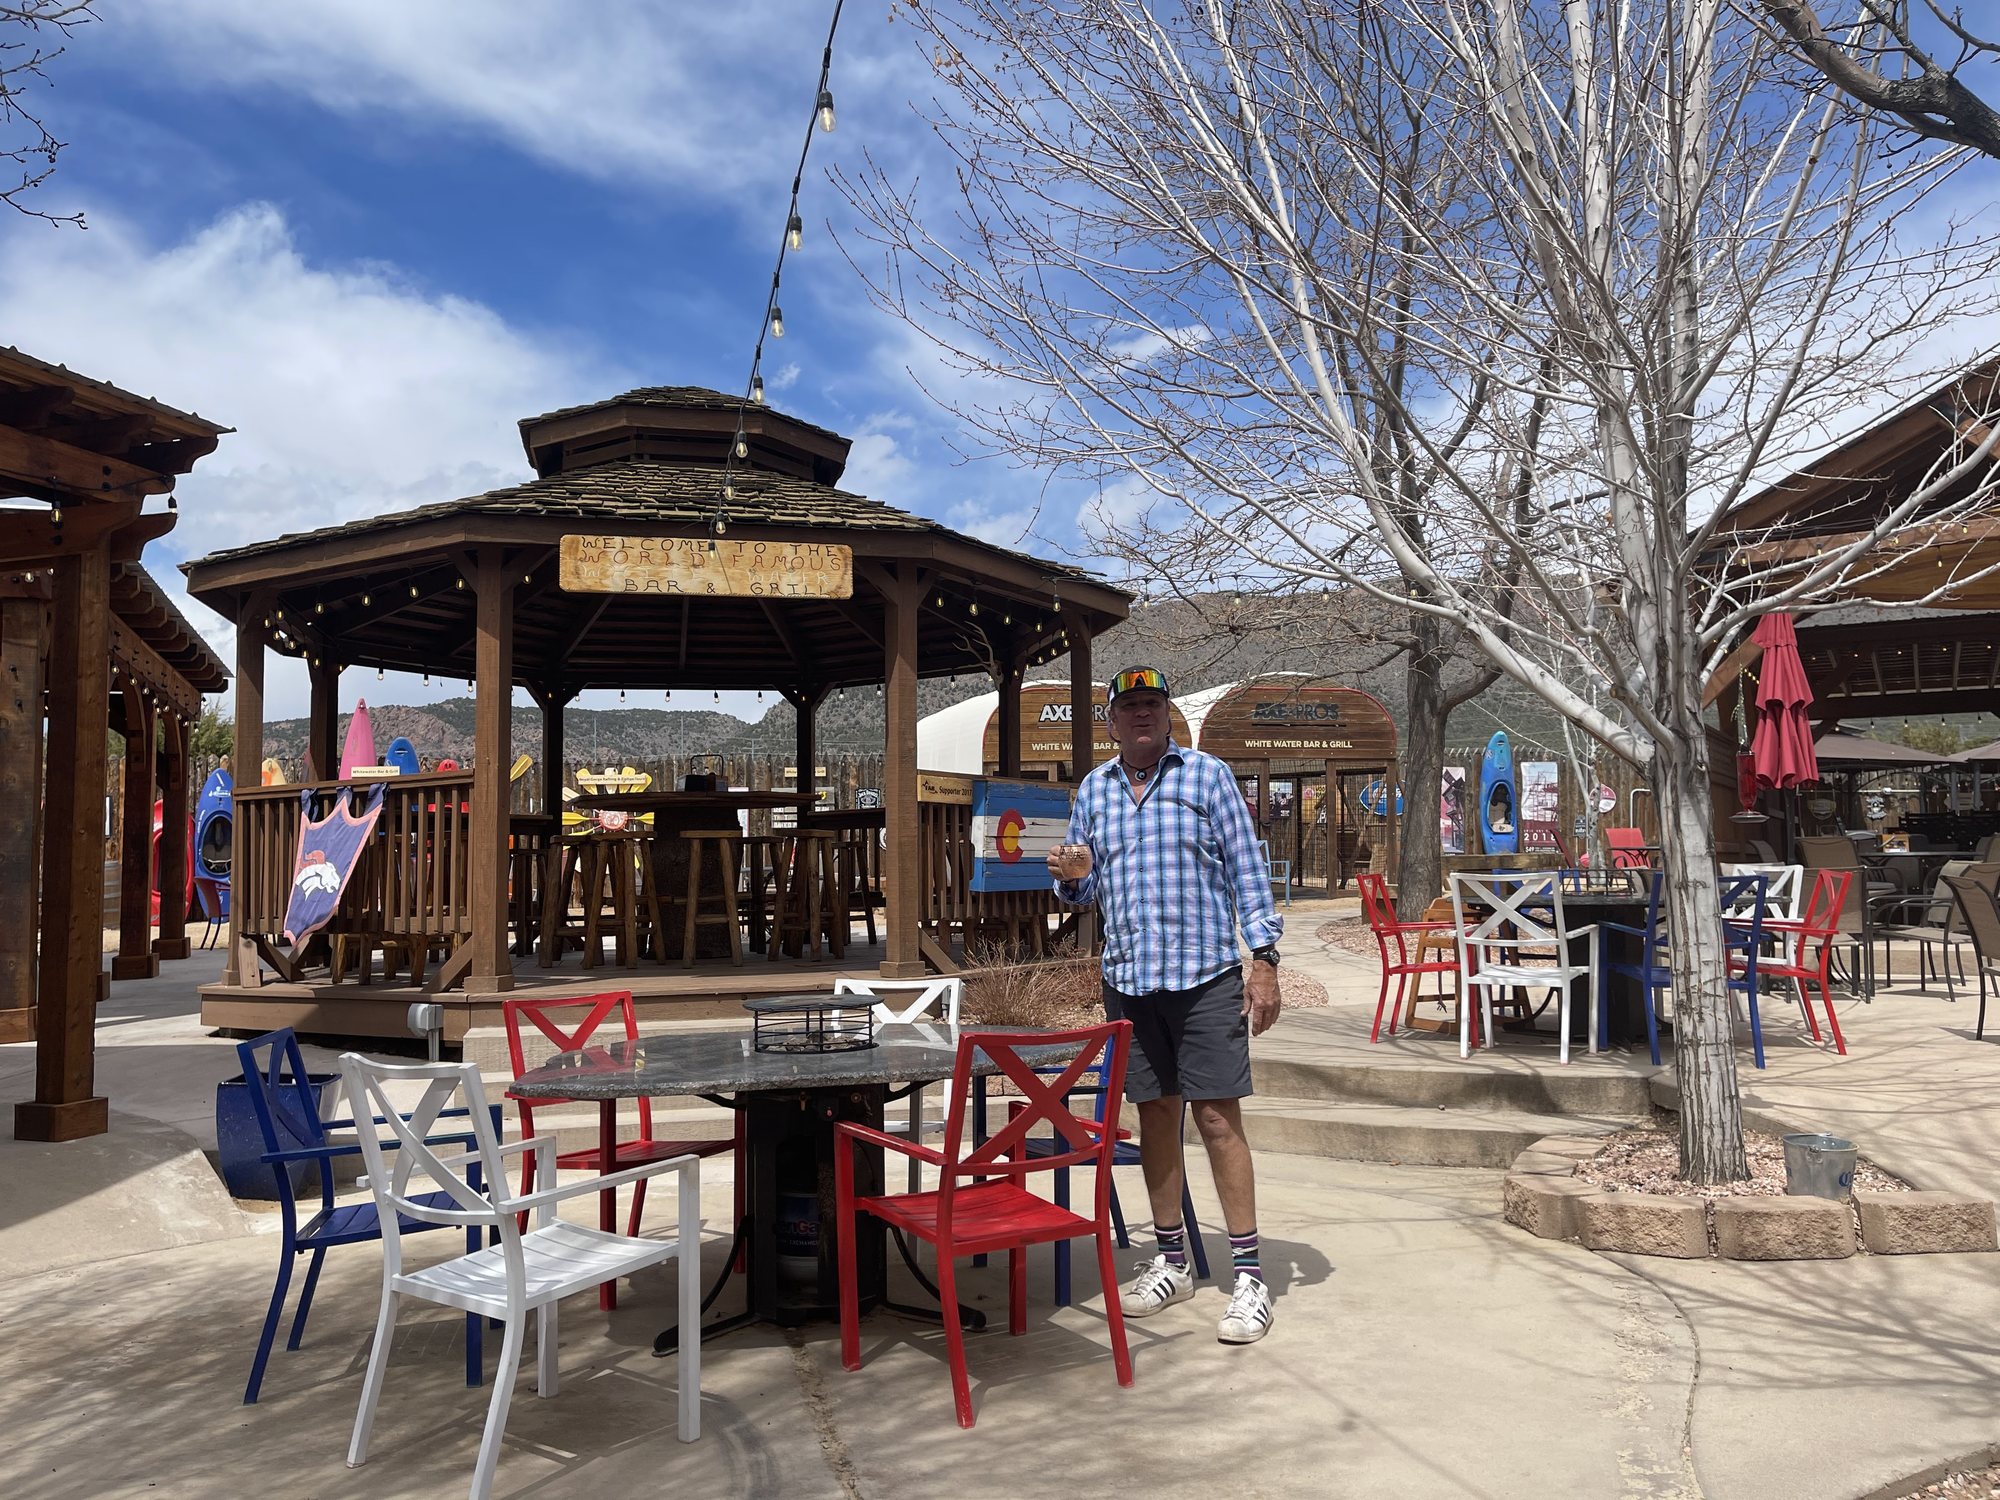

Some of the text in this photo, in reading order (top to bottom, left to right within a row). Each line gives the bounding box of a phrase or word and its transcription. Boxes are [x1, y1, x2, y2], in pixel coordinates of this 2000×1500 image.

[582, 537, 837, 556] WELCOME TO THE
[579, 549, 841, 571] WORLD FAMOUS
[624, 579, 830, 596] BAR & GRILL
[1032, 743, 1060, 751] WHITE
[1244, 740, 1271, 748] WHITE
[1273, 740, 1302, 748] WATER
[938, 786, 961, 796] Supporter
[1523, 833, 1556, 841] 2018
